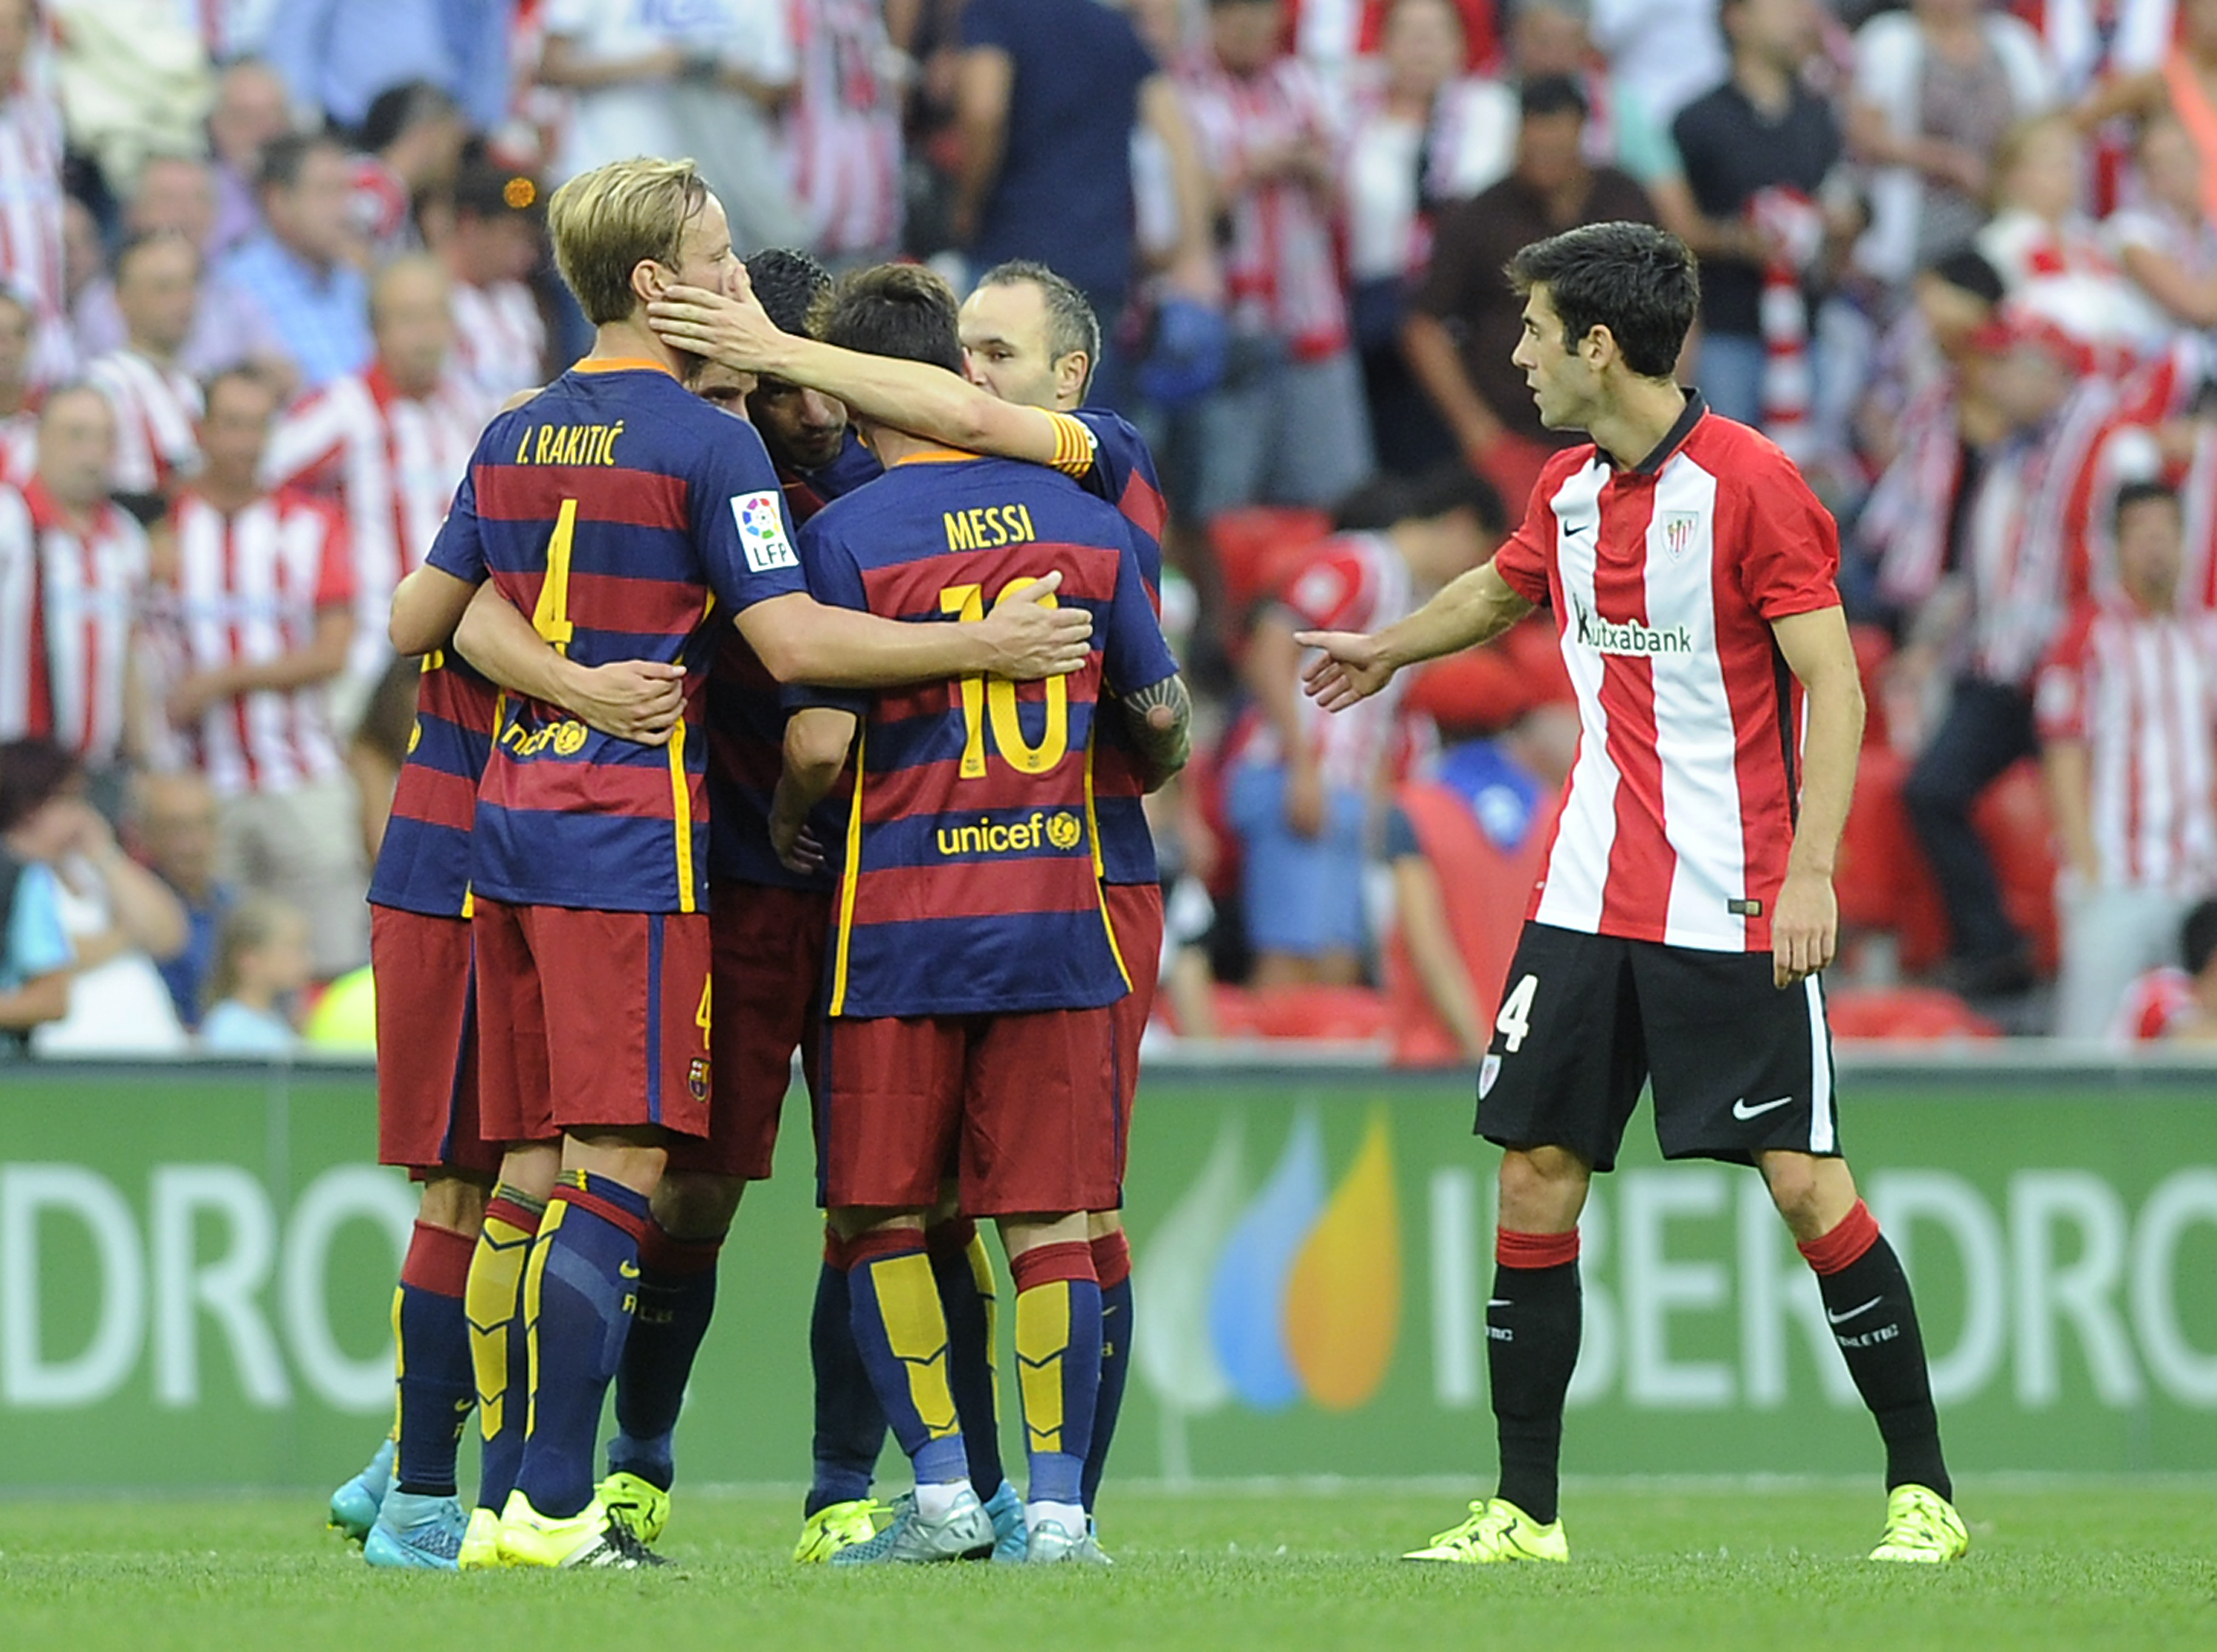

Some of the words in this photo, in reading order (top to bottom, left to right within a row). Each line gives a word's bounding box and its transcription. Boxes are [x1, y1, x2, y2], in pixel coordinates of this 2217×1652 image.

[517, 425, 533, 465] I.
[535, 419, 624, 465] RAKITIĆ
[754, 542, 787, 567] LFP
[944, 503, 1035, 552] MESSI
[532, 499, 578, 656] 4
[1573, 592, 1692, 652] Kutxabank
[939, 576, 1068, 779] 10
[938, 811, 1043, 855] unicef
[695, 972, 712, 1050] 4
[1496, 974, 1539, 1053] 4
